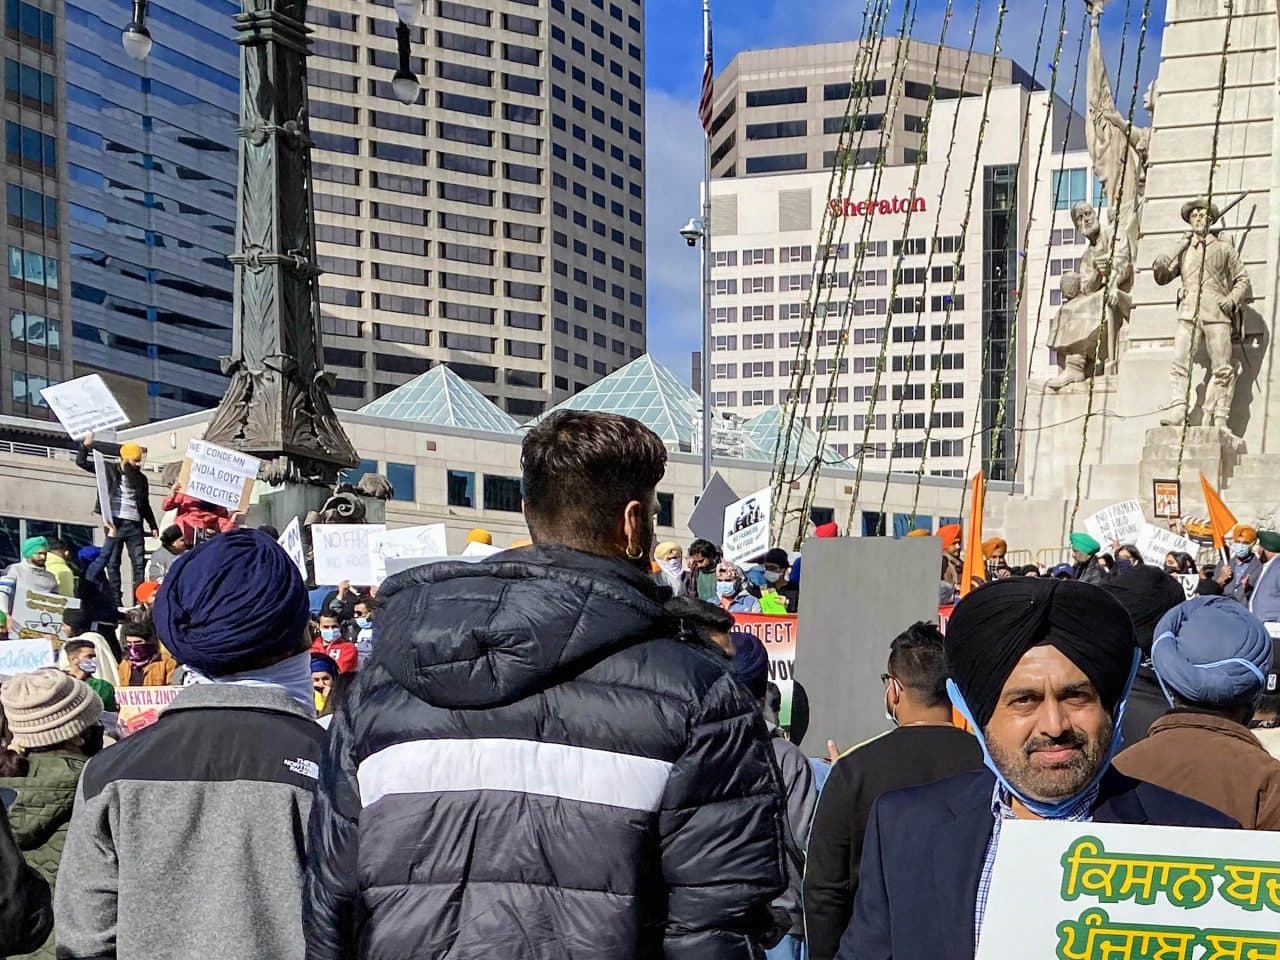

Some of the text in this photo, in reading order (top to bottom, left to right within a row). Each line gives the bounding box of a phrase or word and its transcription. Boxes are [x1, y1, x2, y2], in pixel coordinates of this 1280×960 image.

[829, 195, 926, 217] Sheraton
[192, 462, 241, 485] INDIA GOVT
[189, 479, 241, 504] ATROCITIES
[129, 689, 153, 706] EKTA
[1064, 840, 1218, 904] ਕਿਸਾਨ
